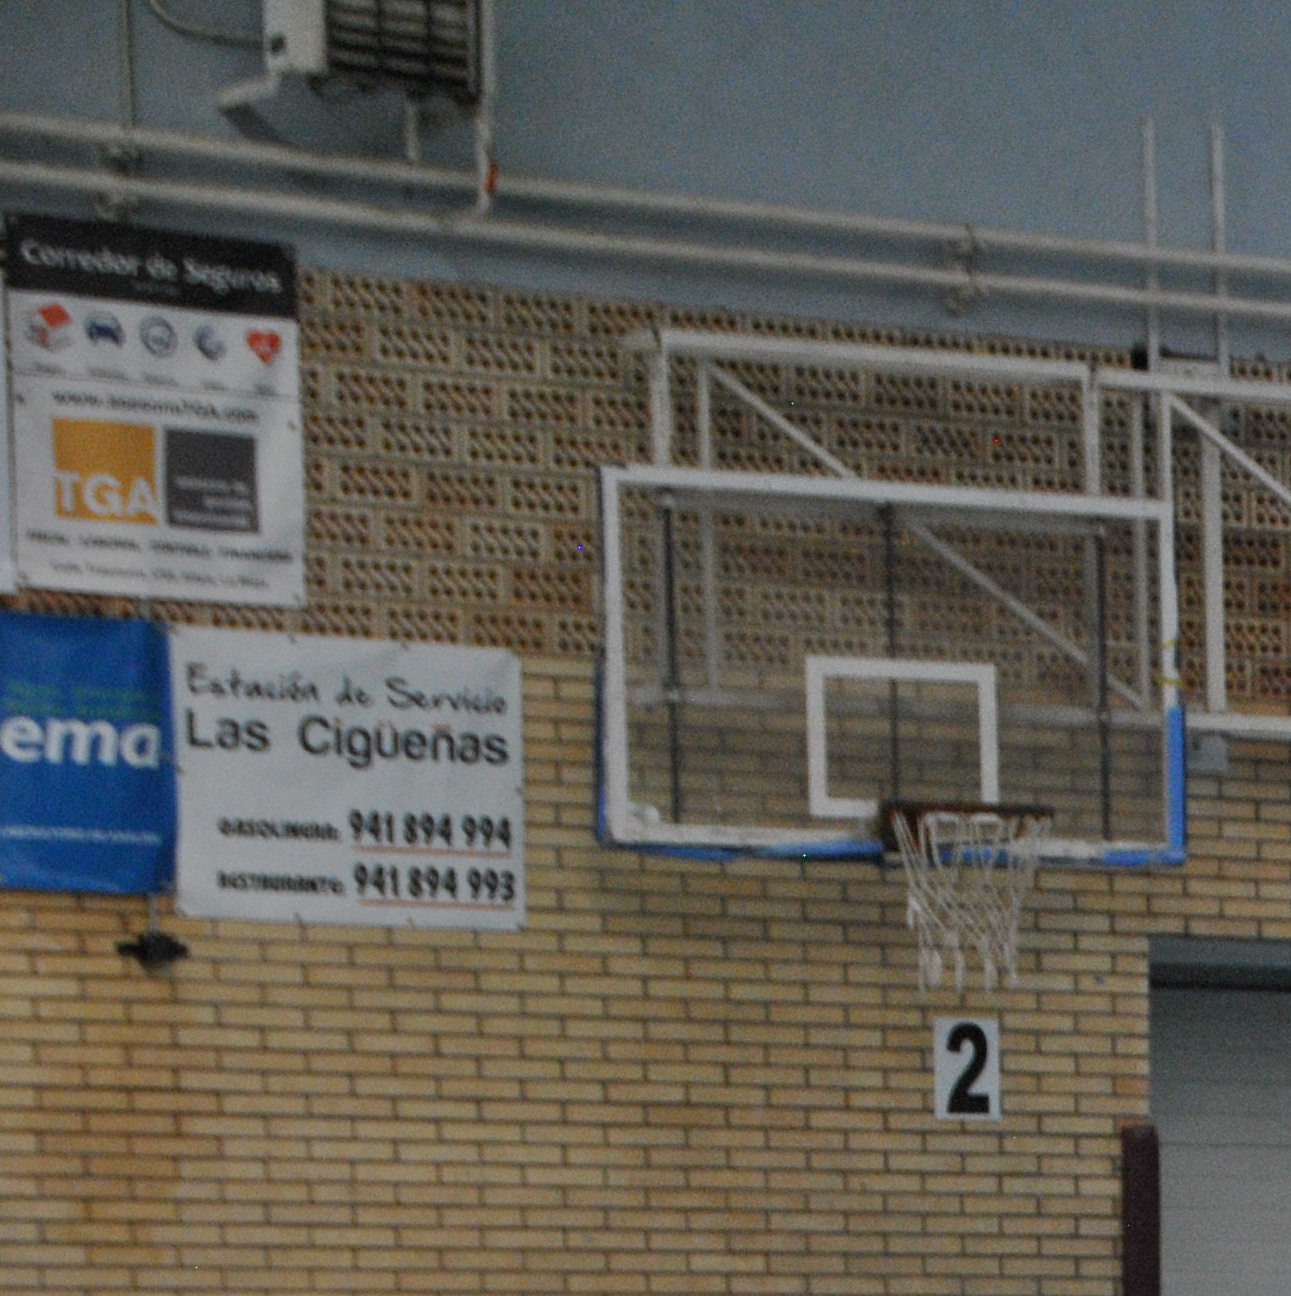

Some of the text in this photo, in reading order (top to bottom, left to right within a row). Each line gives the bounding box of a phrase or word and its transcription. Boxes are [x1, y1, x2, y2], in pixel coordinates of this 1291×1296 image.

[20, 239, 138, 276] Corredor
[146, 252, 178, 279] de
[183, 256, 282, 295] Seguros
[53, 468, 158, 518] TGA
[186, 661, 319, 701] Estación
[335, 675, 371, 708] de
[385, 676, 507, 715] Servicio
[186, 707, 270, 753] Las
[299, 713, 510, 769] Cigüeñas
[349, 809, 394, 844] 941
[402, 811, 452, 847] 894
[461, 813, 511, 850] 994
[354, 861, 399, 897] 941
[408, 865, 457, 899] 894
[466, 866, 516, 902] 993
[946, 1021, 990, 1113] 2
